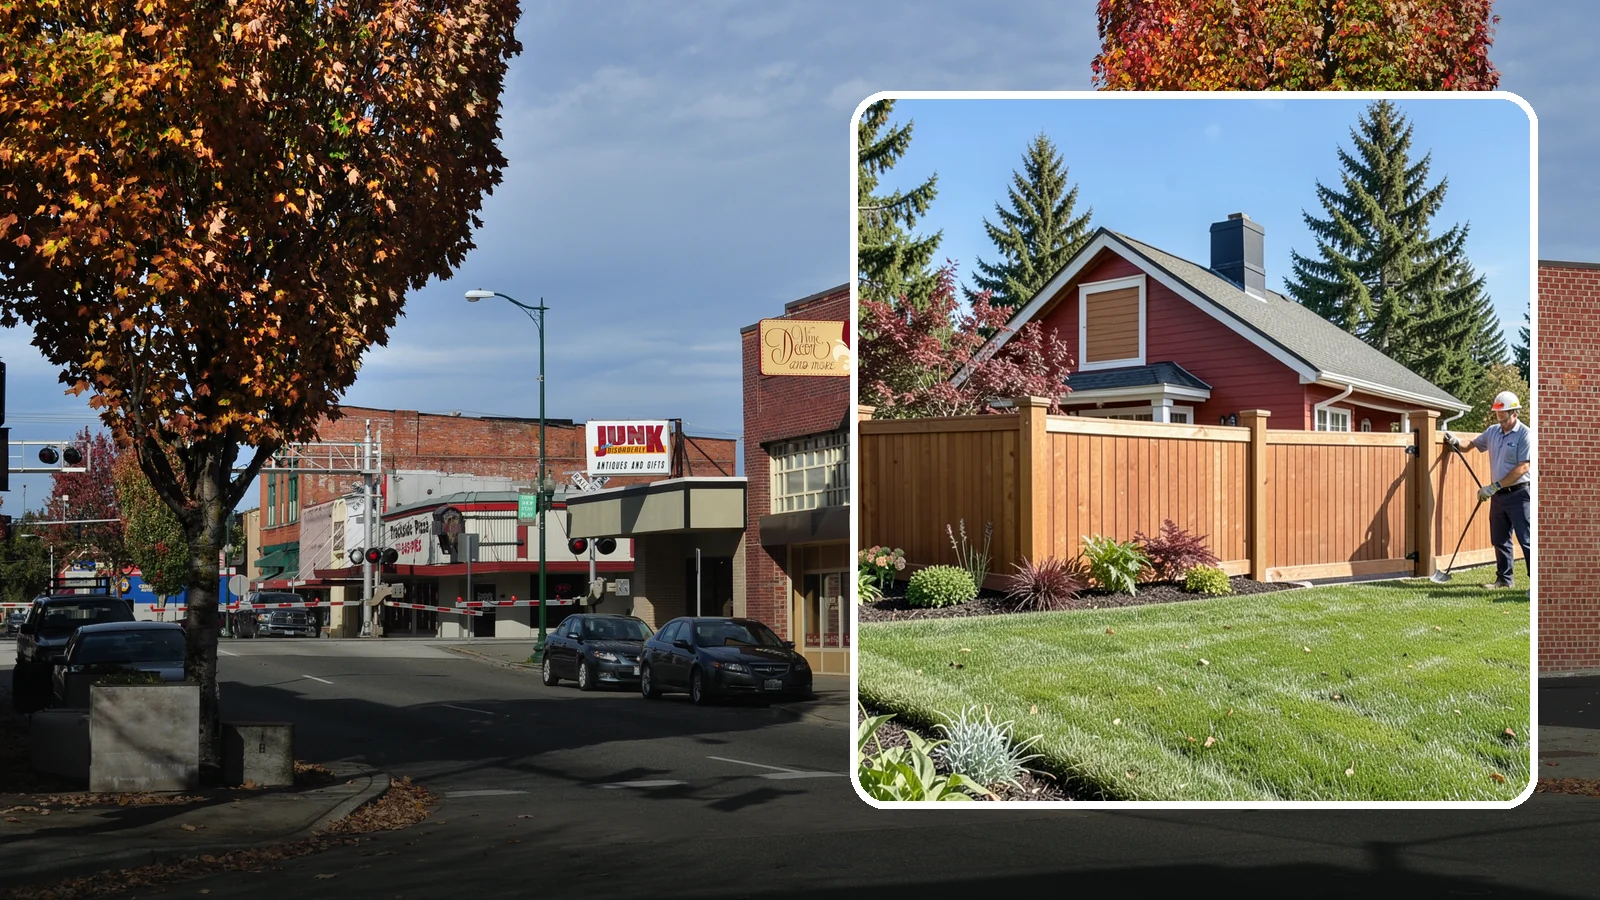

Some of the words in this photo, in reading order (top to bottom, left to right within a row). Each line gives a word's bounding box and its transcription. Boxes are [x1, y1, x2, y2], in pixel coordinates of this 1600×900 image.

[595, 425, 665, 457] JUNK
[607, 446, 646, 454] DISORDERLY
[596, 461, 628, 470] ANTIQUES
[631, 461, 644, 470] AND
[646, 460, 665, 469] GIFTS
[414, 519, 429, 535] Pizza
